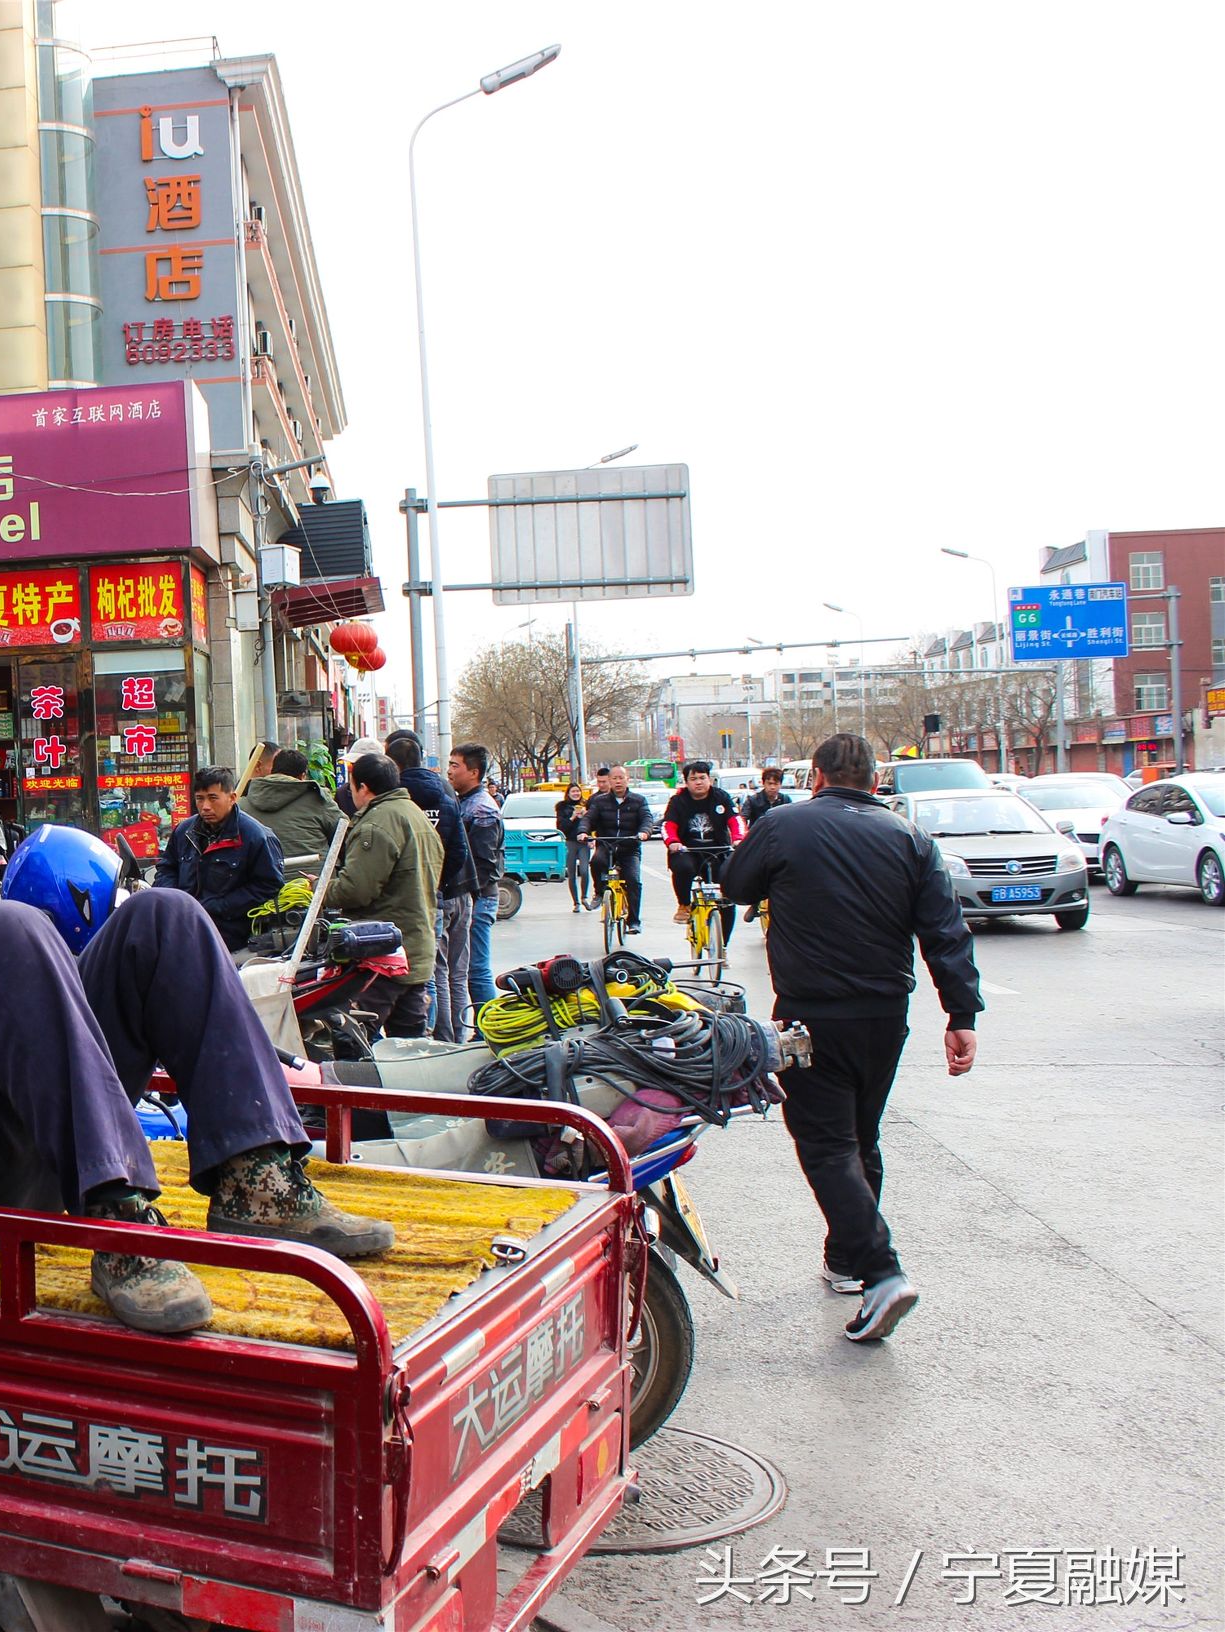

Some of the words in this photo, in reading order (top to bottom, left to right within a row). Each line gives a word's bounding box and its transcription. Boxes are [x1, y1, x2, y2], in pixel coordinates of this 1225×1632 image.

[139, 104, 204, 162] iu
[143, 174, 203, 302] 酒店
[123, 315, 234, 344] 订房电话
[126, 341, 235, 365] 6092333
[32, 400, 162, 428] 首家互联网酒店
[97, 574, 178, 622] 枸杞批发
[1018, 613, 1037, 623] G6
[1087, 626, 1124, 638] 胜利街
[1014, 630, 1052, 641] 丽景街
[31, 685, 66, 769] 茶叶
[121, 677, 158, 758] 超市
[26, 778, 78, 789] 欢迎光临
[105, 775, 183, 788] 宁夏特产中宁枸杞
[452, 1292, 585, 1480] 大运摩托
